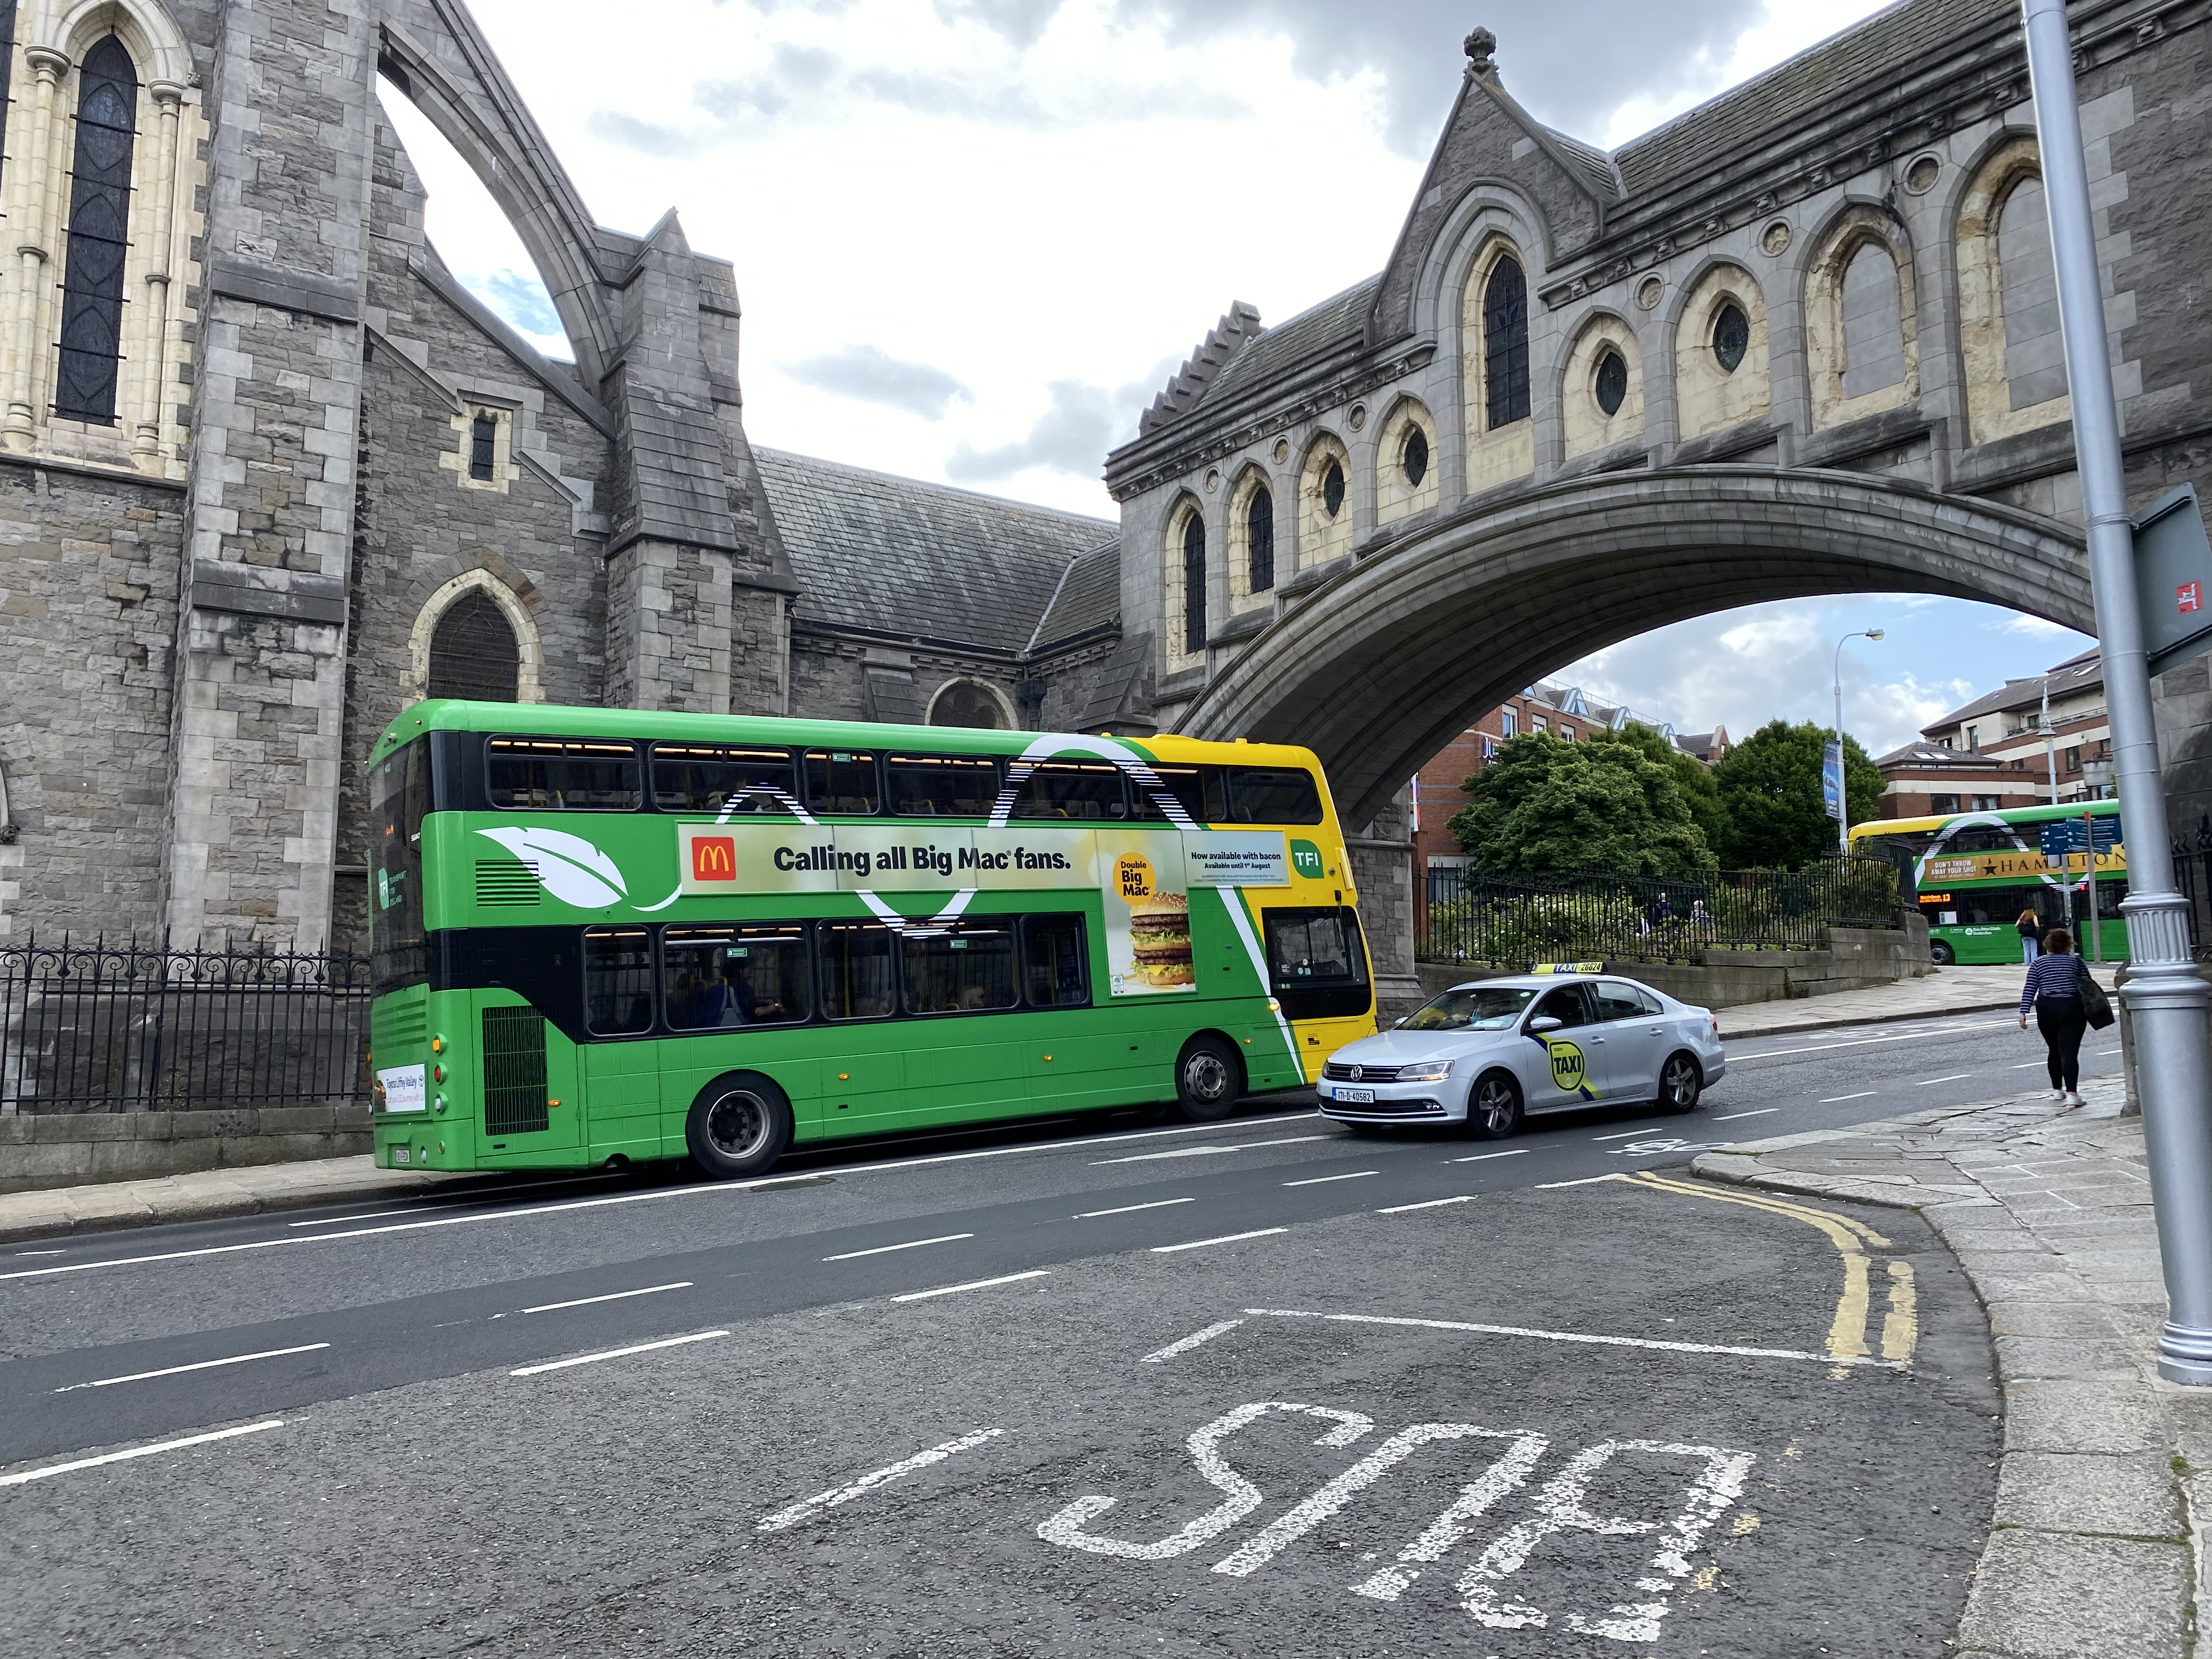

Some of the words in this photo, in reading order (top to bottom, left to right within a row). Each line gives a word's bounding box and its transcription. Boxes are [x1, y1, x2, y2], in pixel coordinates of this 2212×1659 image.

[774, 844, 871, 877] Calling
[877, 847, 907, 870] all
[912, 844, 952, 876] Big
[1014, 847, 1071, 870] fans.
[1209, 851, 1242, 860] available
[1242, 851, 1259, 860] with
[1295, 852, 1319, 866] TFI
[1121, 860, 1147, 868] Double
[1121, 868, 1142, 885] Big
[1943, 893, 1950, 902] 13
[1556, 963, 1578, 972] TAXI
[1554, 1055, 1581, 1074] TAXI
[1037, 1401, 1756, 1643] BUS
